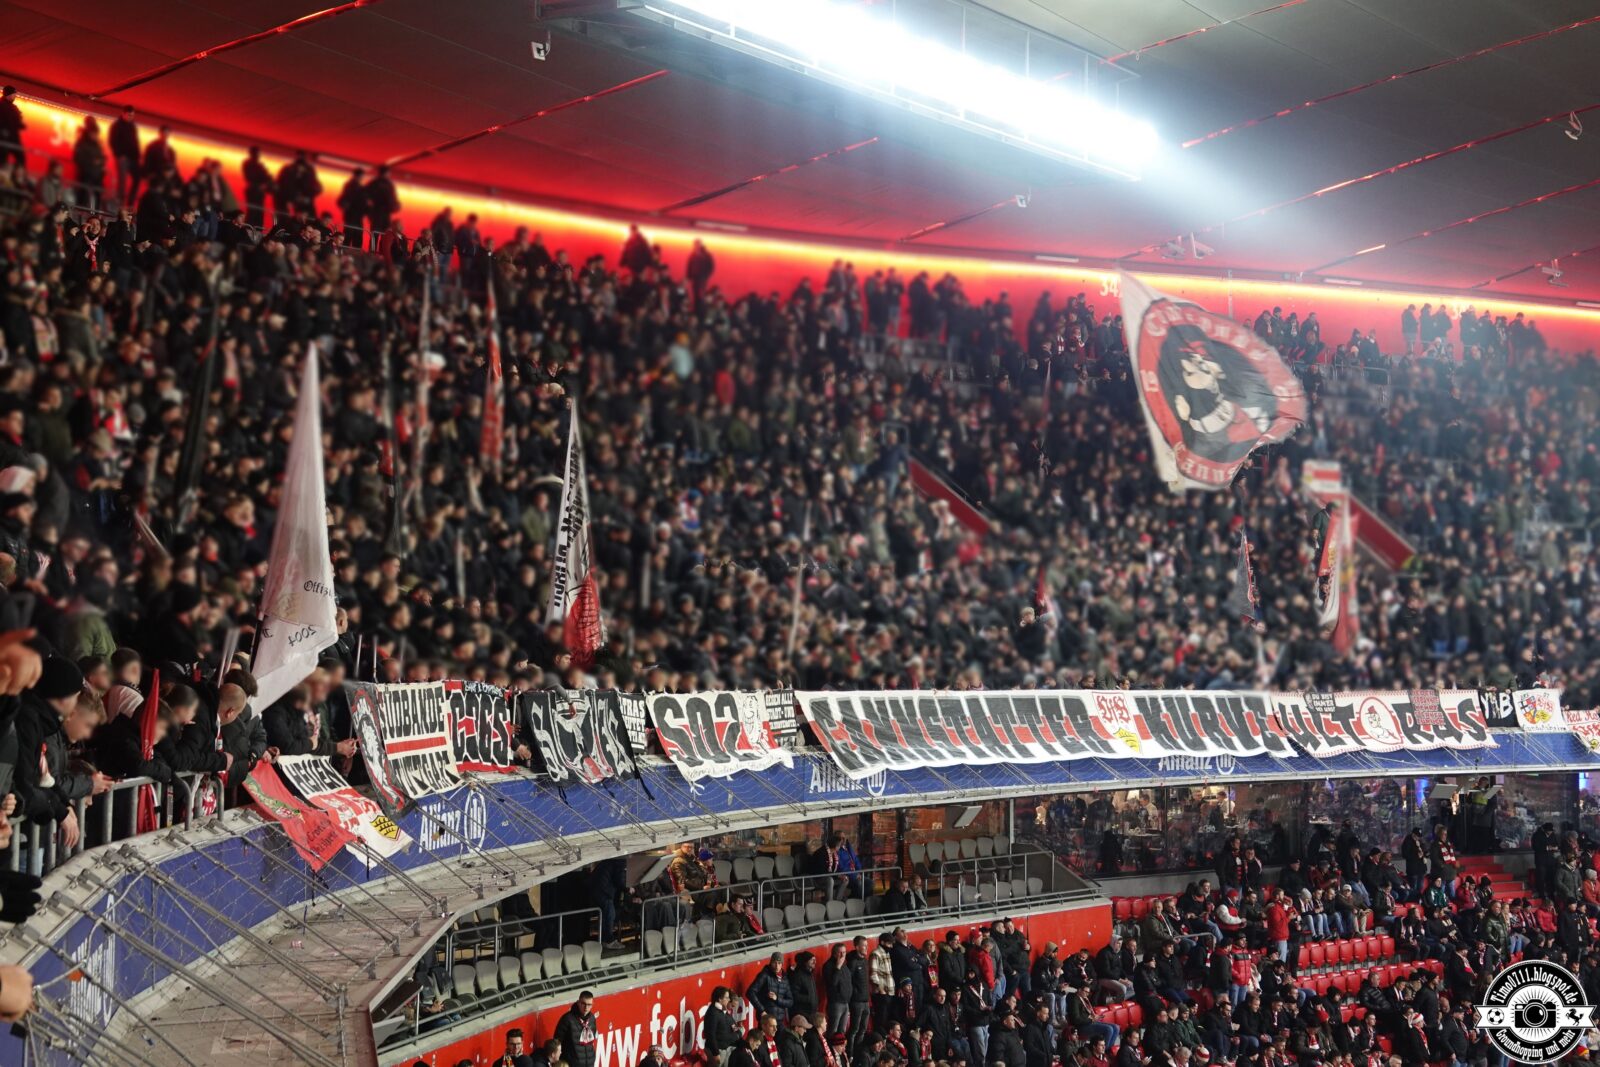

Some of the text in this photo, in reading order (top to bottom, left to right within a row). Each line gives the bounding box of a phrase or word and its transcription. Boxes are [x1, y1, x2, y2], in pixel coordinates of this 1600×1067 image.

[378, 686, 445, 740] SÜDBANDE
[809, 695, 1288, 770] CANNSTATTER KURVE
